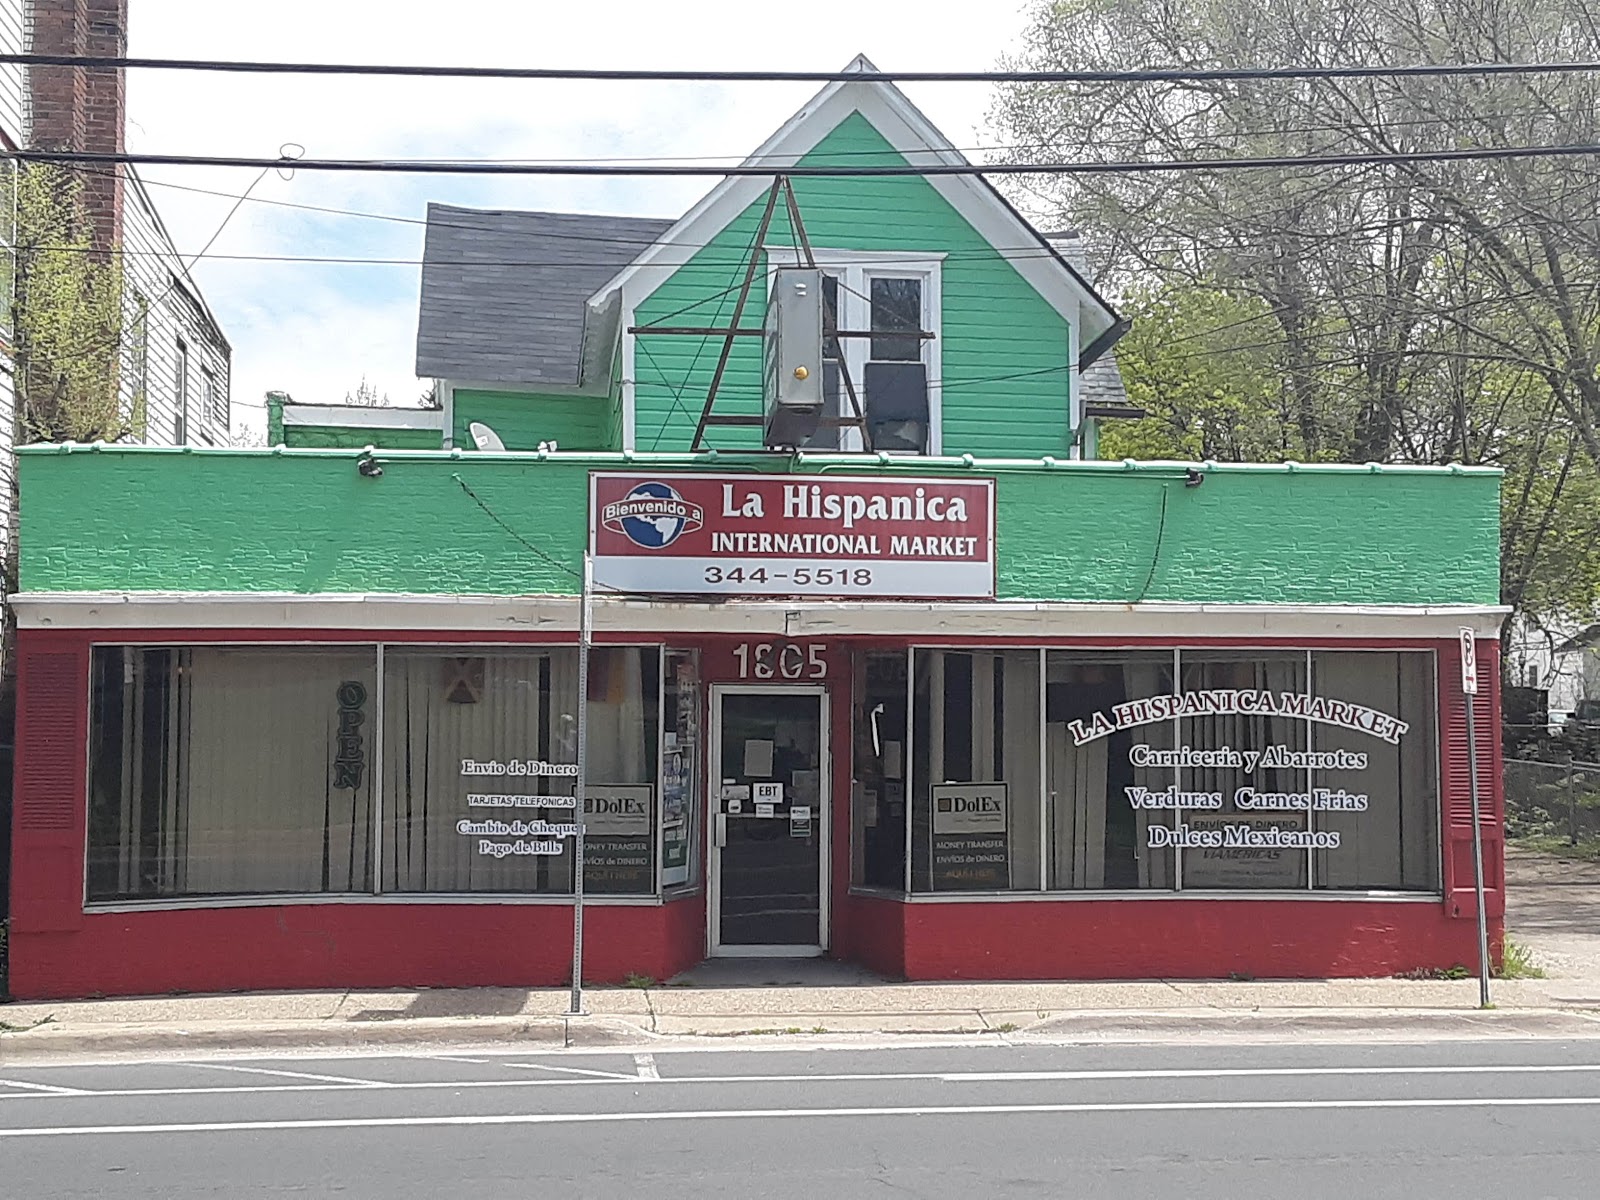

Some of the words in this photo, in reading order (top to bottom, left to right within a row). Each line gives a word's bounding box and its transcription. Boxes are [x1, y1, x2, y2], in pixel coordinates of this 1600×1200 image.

[606, 501, 686, 518] Bienvenido
[692, 509, 701, 520] a
[721, 483, 764, 518] La
[783, 485, 969, 529] Hispanica
[711, 532, 881, 555] INTERNATIONAL
[889, 534, 978, 557] MARKET
[704, 566, 872, 587] 344-5518
[1068, 711, 1115, 746] LA
[1112, 689, 1279, 729] HISPANICA
[1280, 693, 1409, 744] MARKET
[333, 681, 367, 789] OPEN
[507, 759, 526, 775] de
[527, 760, 578, 776] Dinero
[1129, 744, 1242, 768] Carniceria
[1242, 751, 1260, 773] y
[1260, 746, 1367, 769] Abarrotes
[759, 785, 778, 797] EBT
[1125, 786, 1222, 809] Verduras
[1234, 787, 1309, 810] Carnes
[1313, 788, 1368, 811] Frias
[467, 794, 512, 807] TARJETAS
[514, 795, 577, 808] TELEFONICAS
[595, 798, 646, 813] DolEx
[954, 797, 1001, 812] DolEx
[457, 820, 509, 834] Cambio
[510, 820, 527, 835] de
[528, 820, 586, 839] Cheque
[1148, 824, 1222, 848] Dulces
[1223, 826, 1340, 849] Mexicanos
[479, 840, 514, 858] Pago
[515, 840, 530, 854] de
[531, 840, 563, 855] Bills
[583, 842, 605, 851] ONEY
